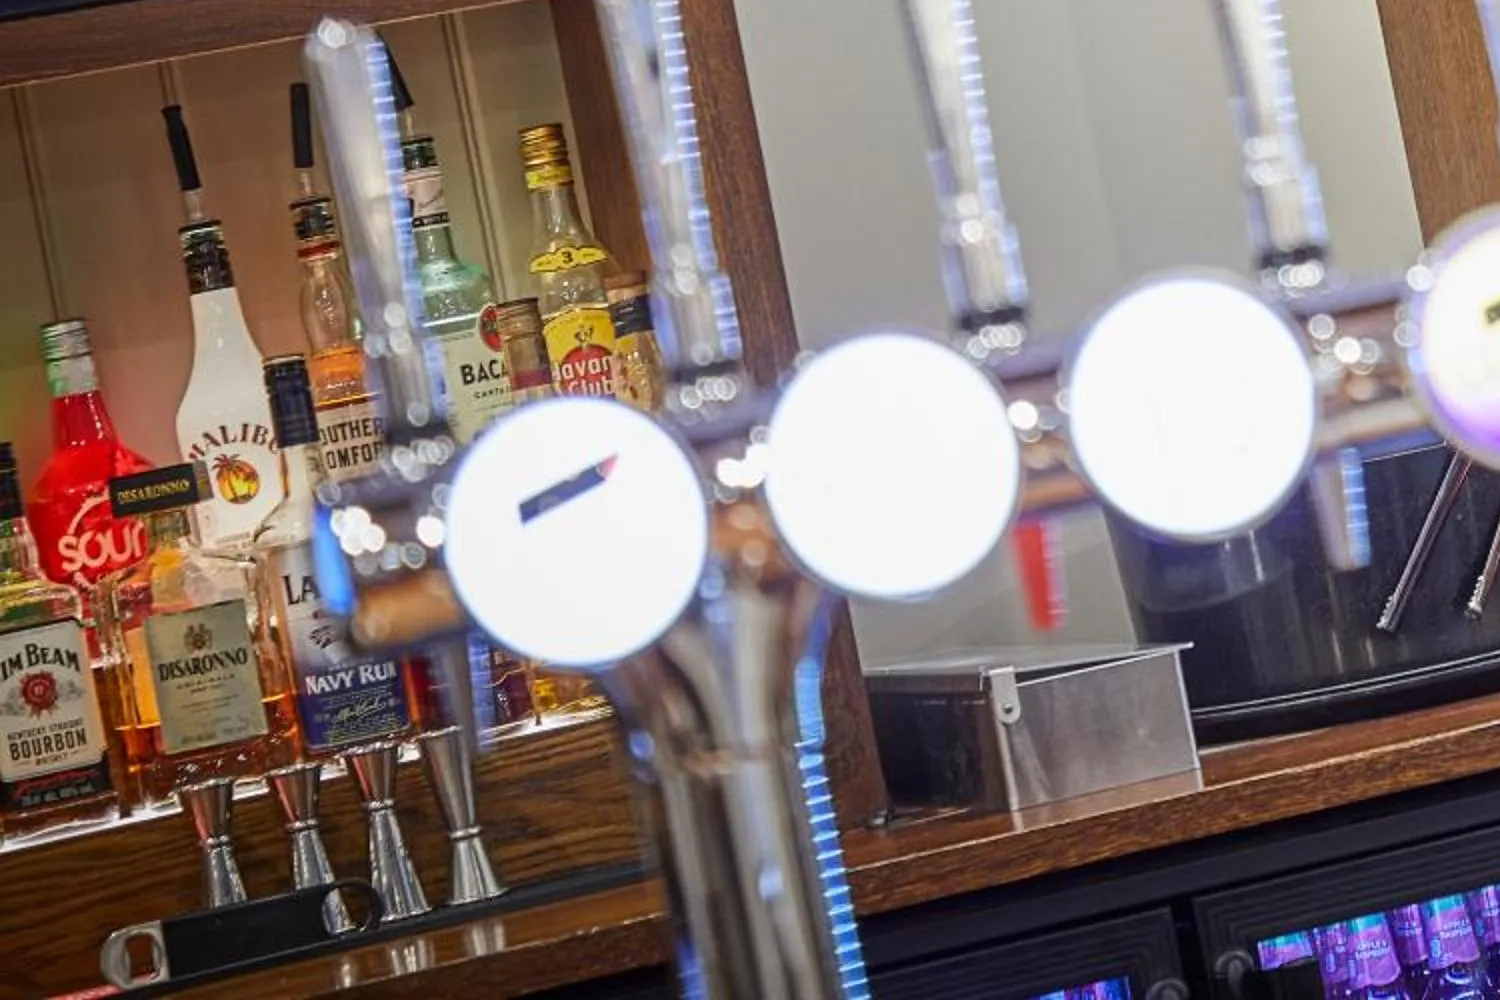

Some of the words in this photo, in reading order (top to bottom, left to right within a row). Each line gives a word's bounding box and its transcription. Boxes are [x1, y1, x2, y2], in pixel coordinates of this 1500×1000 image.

[562, 251, 573, 264] 3
[0, 654, 24, 681] IM
[24, 642, 81, 674] BEAM
[158, 647, 249, 682] DISARONNO
[305, 668, 356, 696] NAVY
[9, 727, 87, 761] BOURBON
